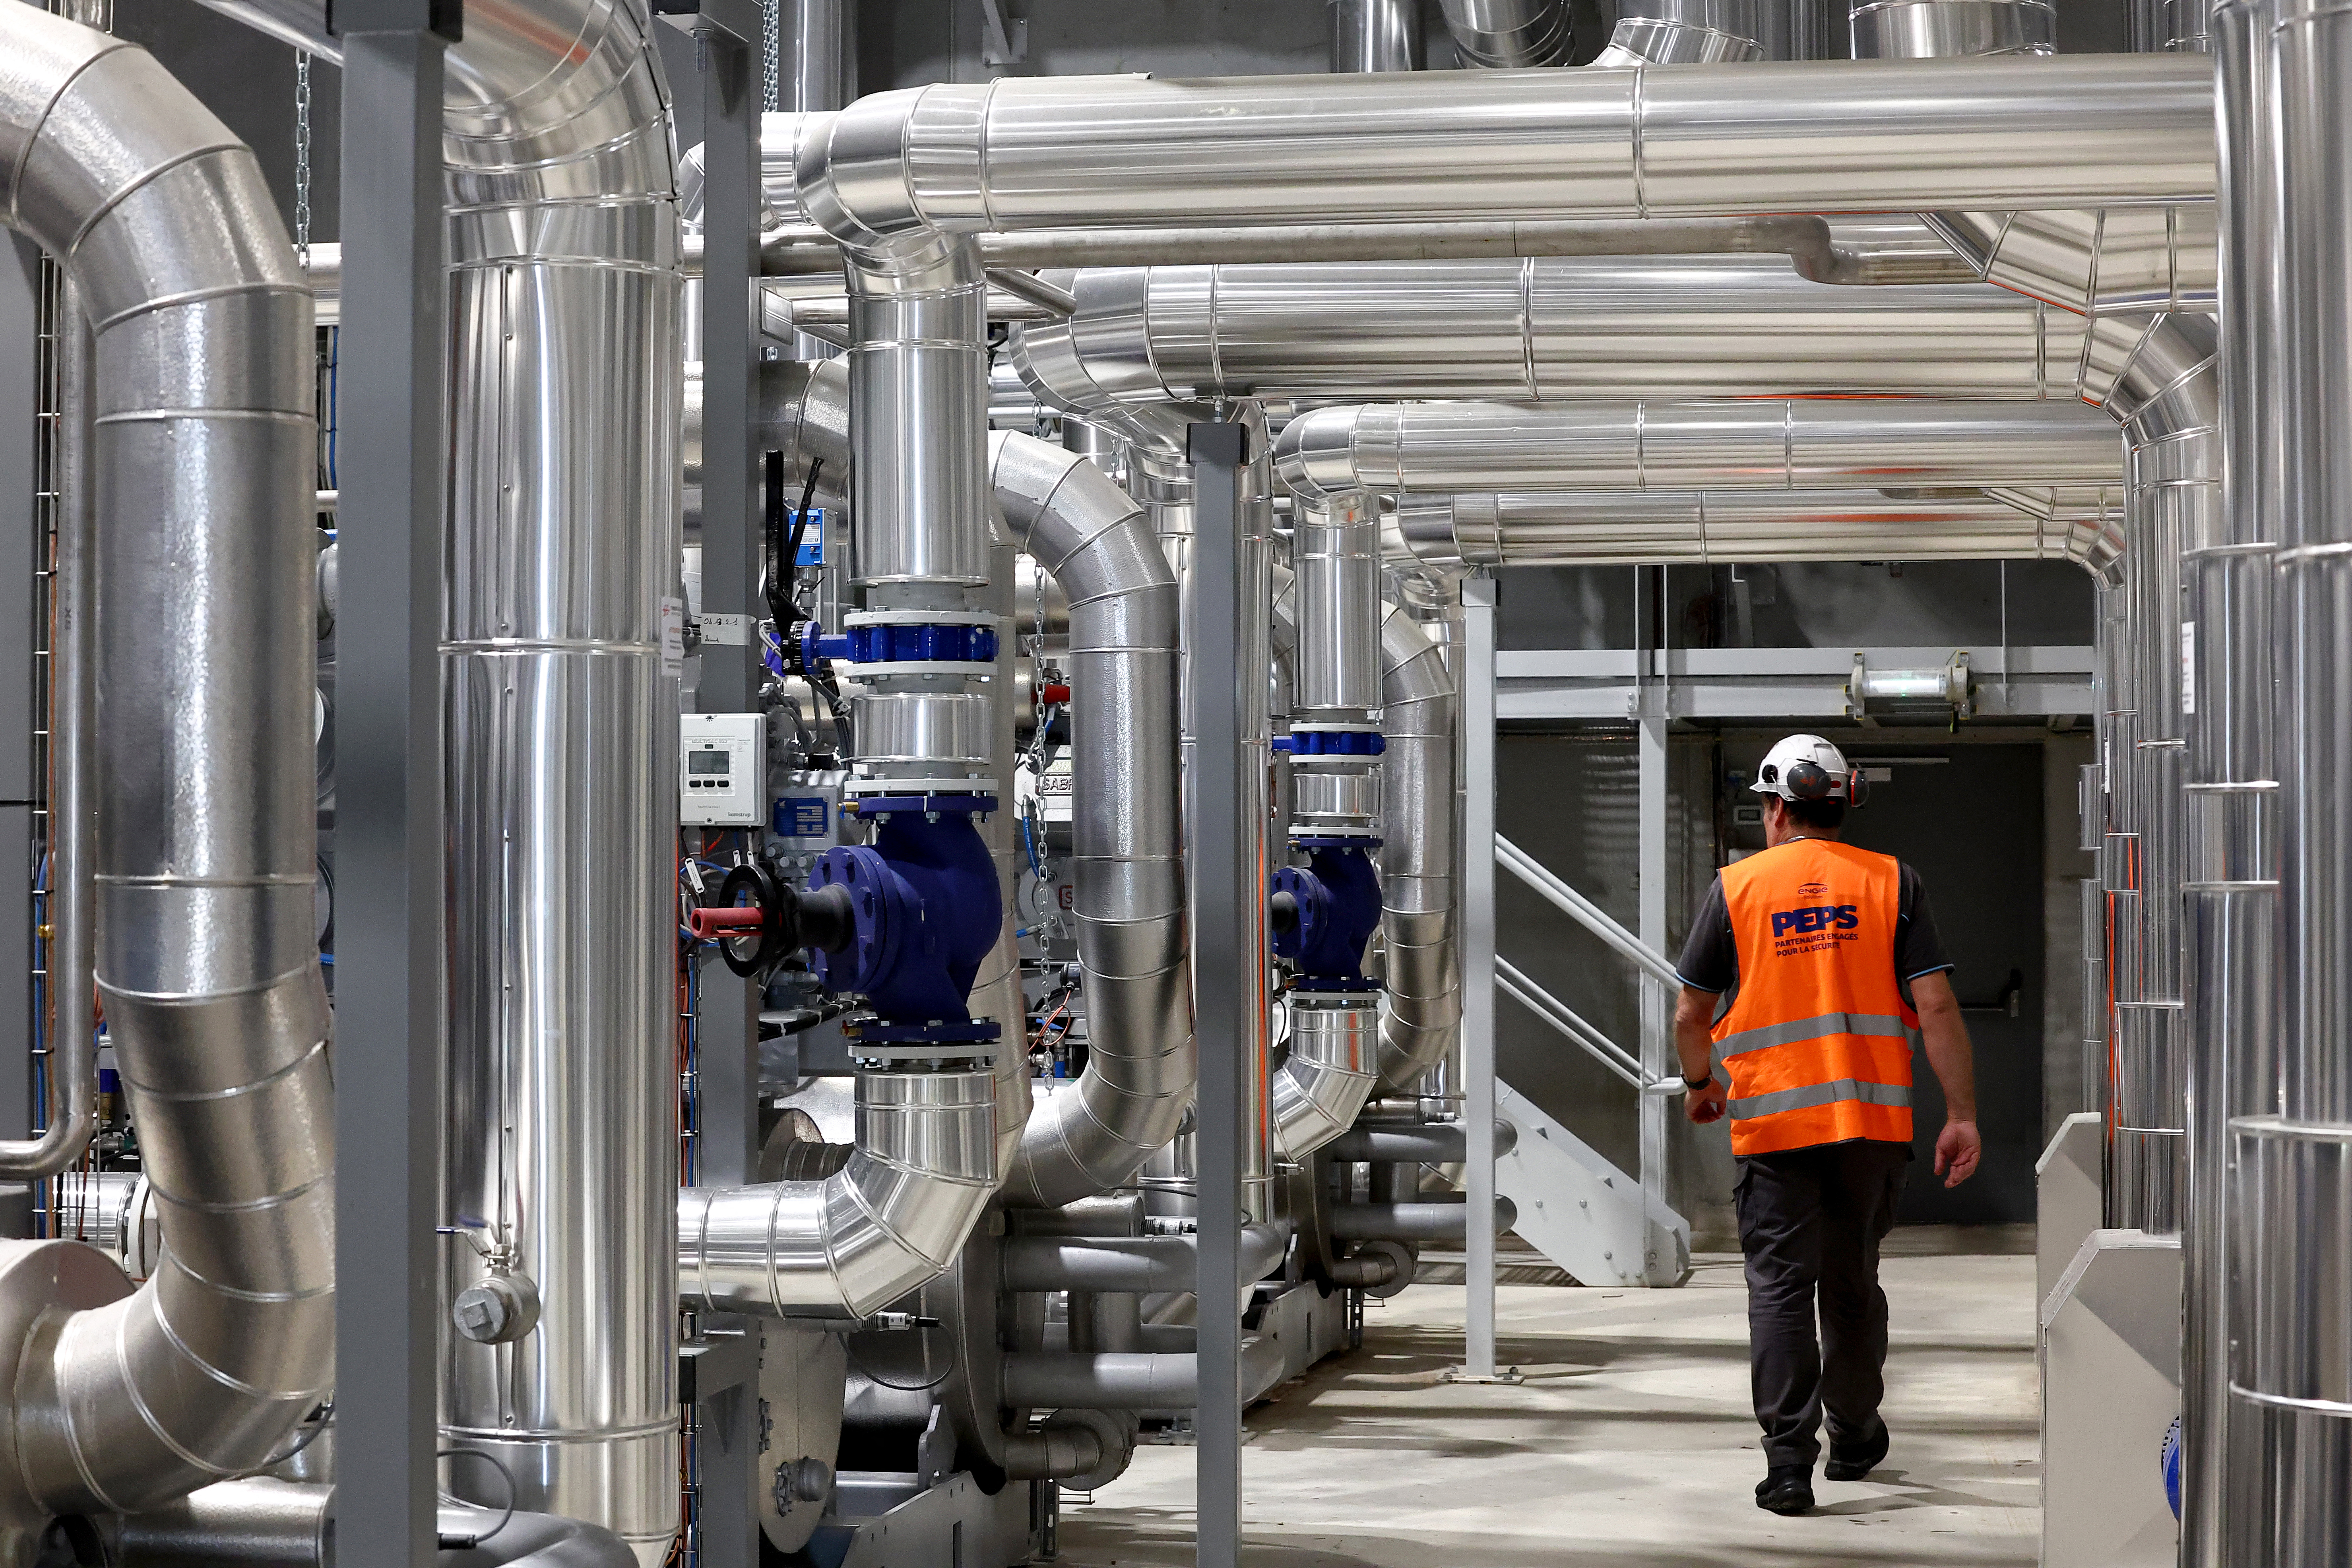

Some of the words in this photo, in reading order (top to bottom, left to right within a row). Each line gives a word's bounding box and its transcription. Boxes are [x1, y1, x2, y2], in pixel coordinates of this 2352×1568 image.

[1772, 905, 1859, 937] PEPS
[1775, 934, 1825, 948] PARTENAIRES
[1776, 948, 1798, 957] POUR
